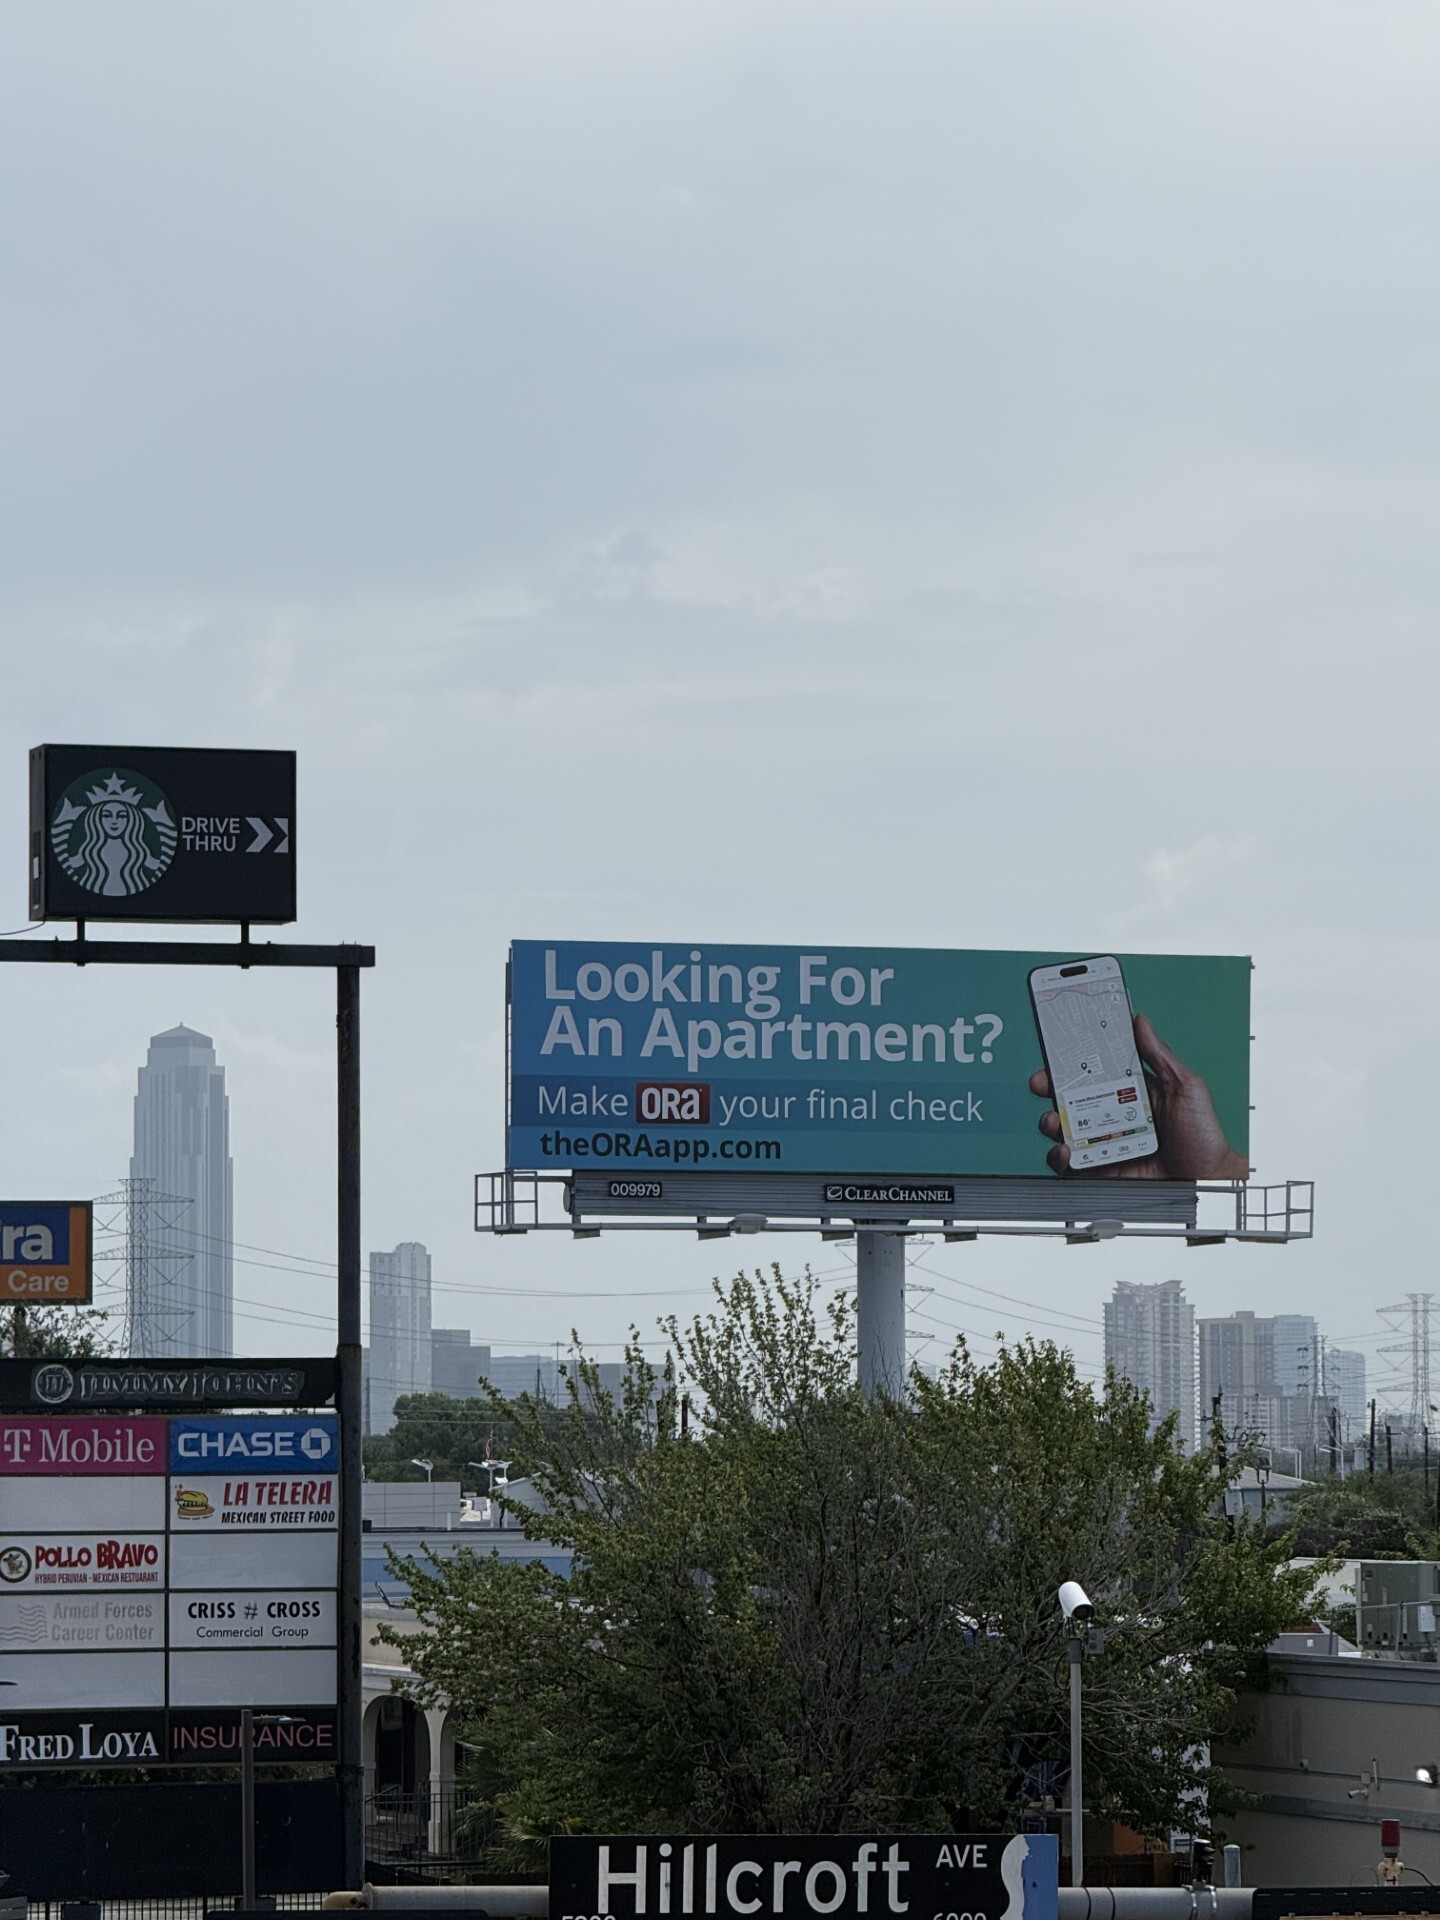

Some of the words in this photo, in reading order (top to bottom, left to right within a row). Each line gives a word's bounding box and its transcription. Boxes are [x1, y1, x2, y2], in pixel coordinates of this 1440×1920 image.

[182, 817, 240, 834] DRIVE
[182, 835, 237, 852] THRU
[544, 949, 781, 1020] Looking
[799, 955, 894, 1007] For
[540, 1005, 622, 1057] An
[640, 1007, 1004, 1073] Apartment?
[538, 1085, 628, 1116] Make
[719, 1095, 797, 1126] your
[806, 1088, 877, 1120] final
[889, 1090, 984, 1121] check
[539, 1130, 782, 1163] theORAapp.com
[611, 1183, 661, 1197] 009979
[0, 1225, 53, 1260] ra
[8, 1270, 69, 1292] Care
[81, 1372, 188, 1400] JIMMY
[38, 1429, 155, 1463] Mobile
[178, 1432, 296, 1457] CHASE
[223, 1482, 249, 1506] LA
[255, 1480, 332, 1506] TELERA
[221, 1511, 266, 1524] MEXICAN
[270, 1511, 305, 1524] STREET
[308, 1510, 335, 1523] FOOD
[35, 1545, 92, 1570] POLLO
[97, 1540, 158, 1570] BRAVO
[93, 1572, 120, 1583] MEXICAN
[53, 1602, 99, 1619] Armed
[104, 1601, 152, 1618] Forces
[188, 1602, 236, 1619] CRISS
[267, 1601, 321, 1618] CROSS
[52, 1624, 99, 1641] Career
[106, 1623, 154, 1641] Center
[196, 1626, 263, 1638] Commercial
[272, 1625, 309, 1639] Group
[0, 1725, 74, 1761] FRED
[79, 1723, 160, 1759] LOYA
[598, 1842, 909, 1914] Hillcroft
[935, 1844, 987, 1868] AVE
